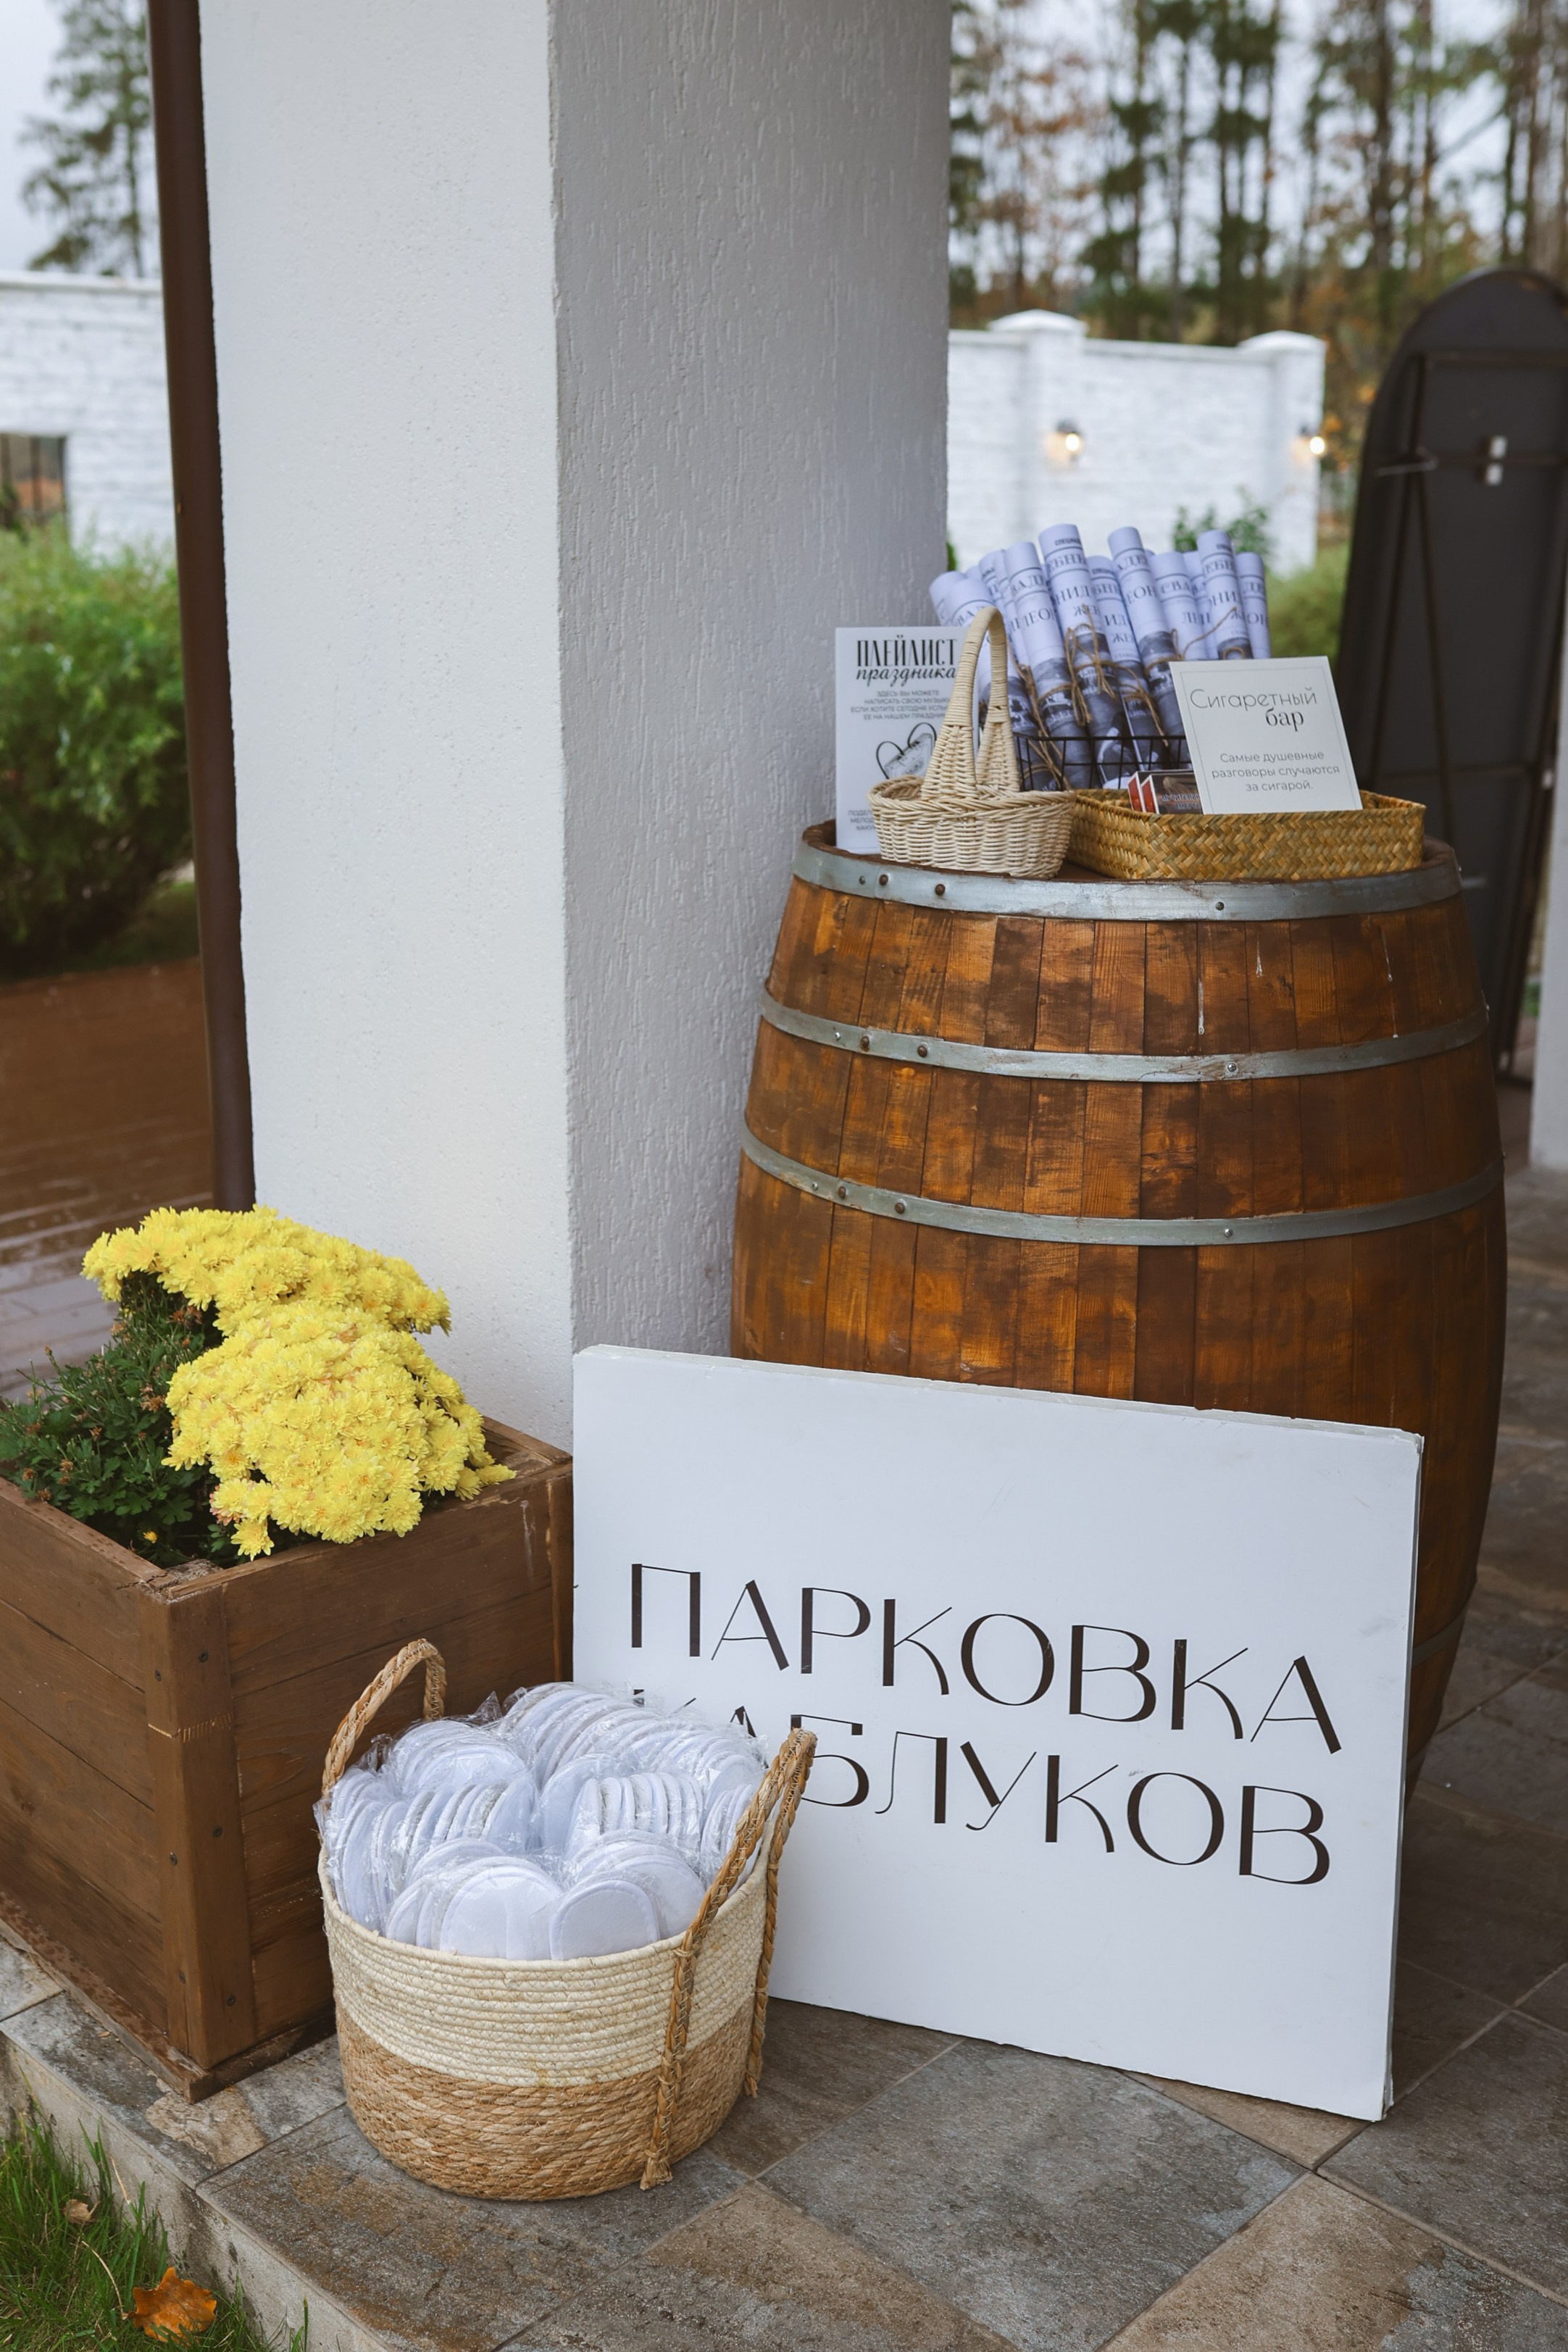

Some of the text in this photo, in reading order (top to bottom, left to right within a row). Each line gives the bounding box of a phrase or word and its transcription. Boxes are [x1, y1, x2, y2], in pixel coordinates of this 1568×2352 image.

[856, 634, 957, 667] ПЛЕЙЛИСТ
[856, 667, 956, 687] праздника
[1190, 687, 1318, 712] Сигаретный
[1265, 707, 1304, 732] бар
[1219, 751, 1325, 764] Самые душевные
[1212, 765, 1340, 780] разговоры случаются
[1262, 780, 1314, 791] сигарой.
[630, 1562, 1341, 1755] ПАРКОВКА
[633, 1689, 1330, 1885] БЛУКОВ
